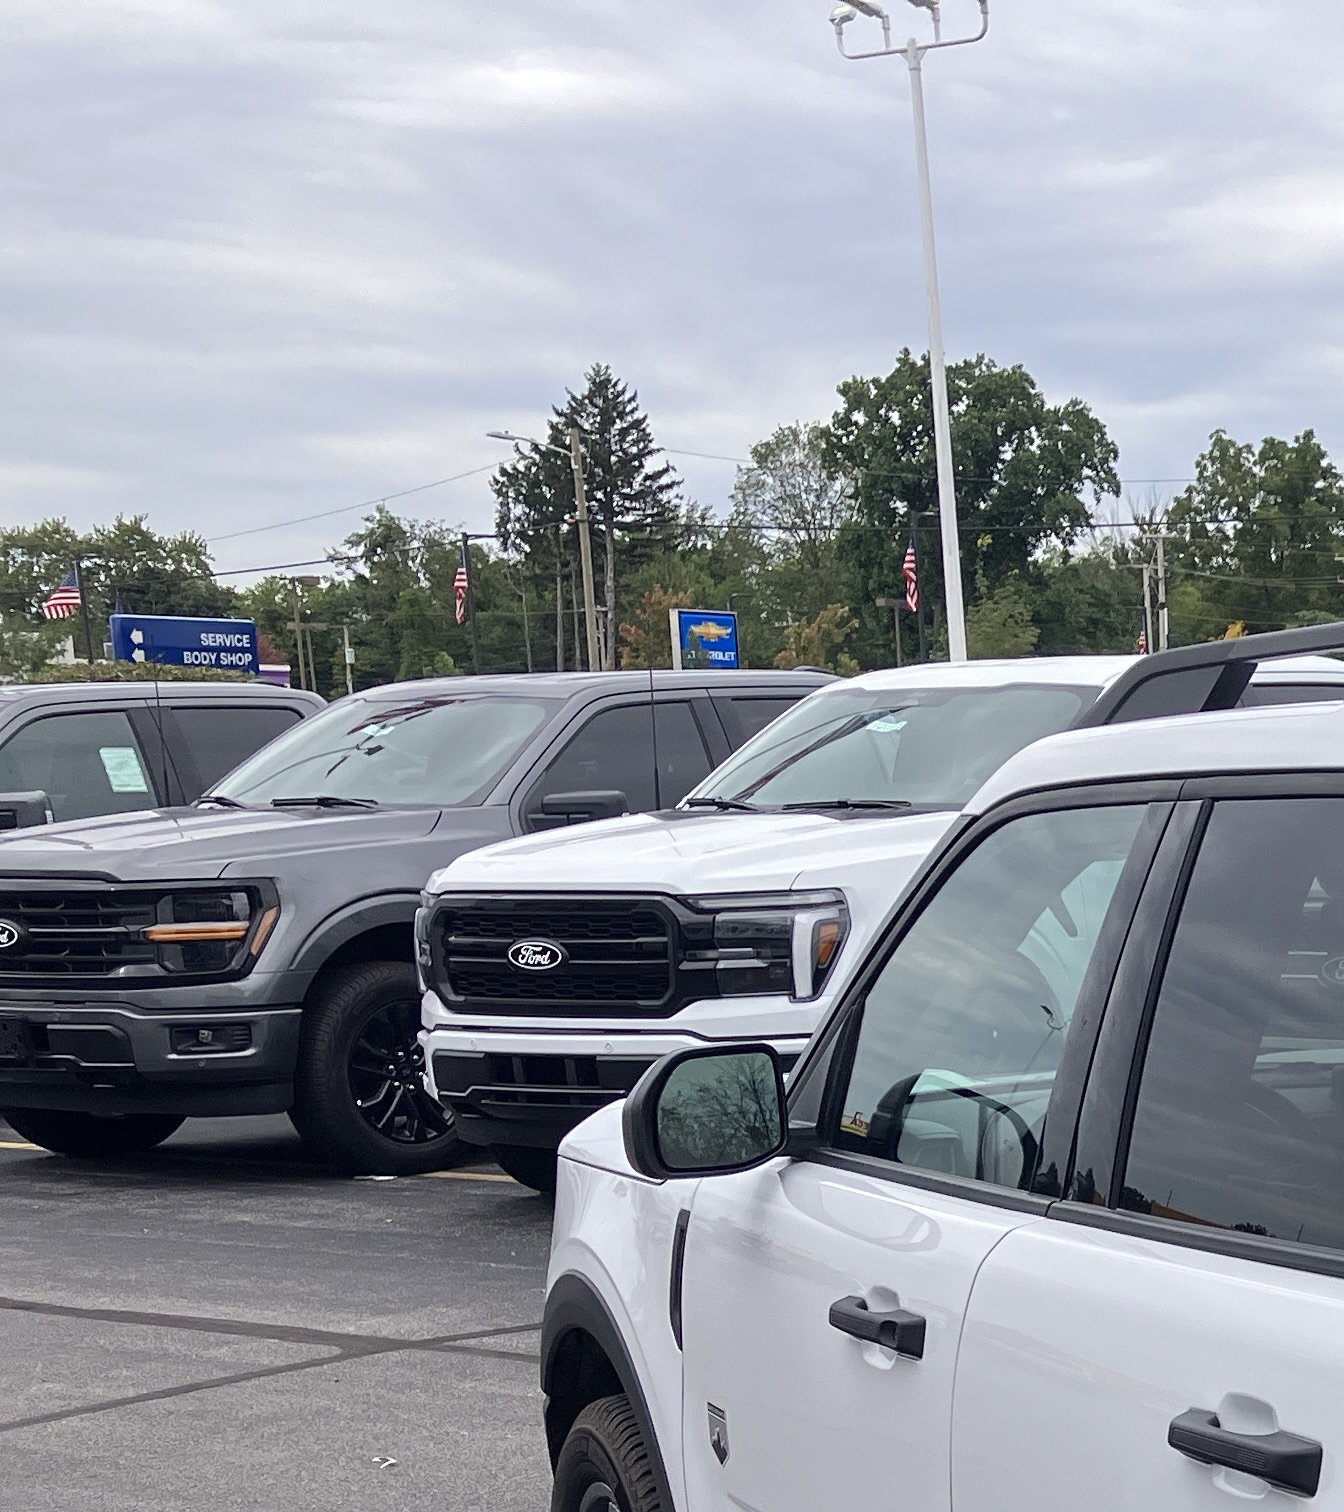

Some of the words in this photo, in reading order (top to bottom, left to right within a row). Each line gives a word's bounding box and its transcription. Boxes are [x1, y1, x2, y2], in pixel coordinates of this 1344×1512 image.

[200, 633, 251, 647] SERVICE
[183, 652, 217, 665] BODY
[219, 652, 253, 666] SHOP
[518, 945, 551, 965] Ford
